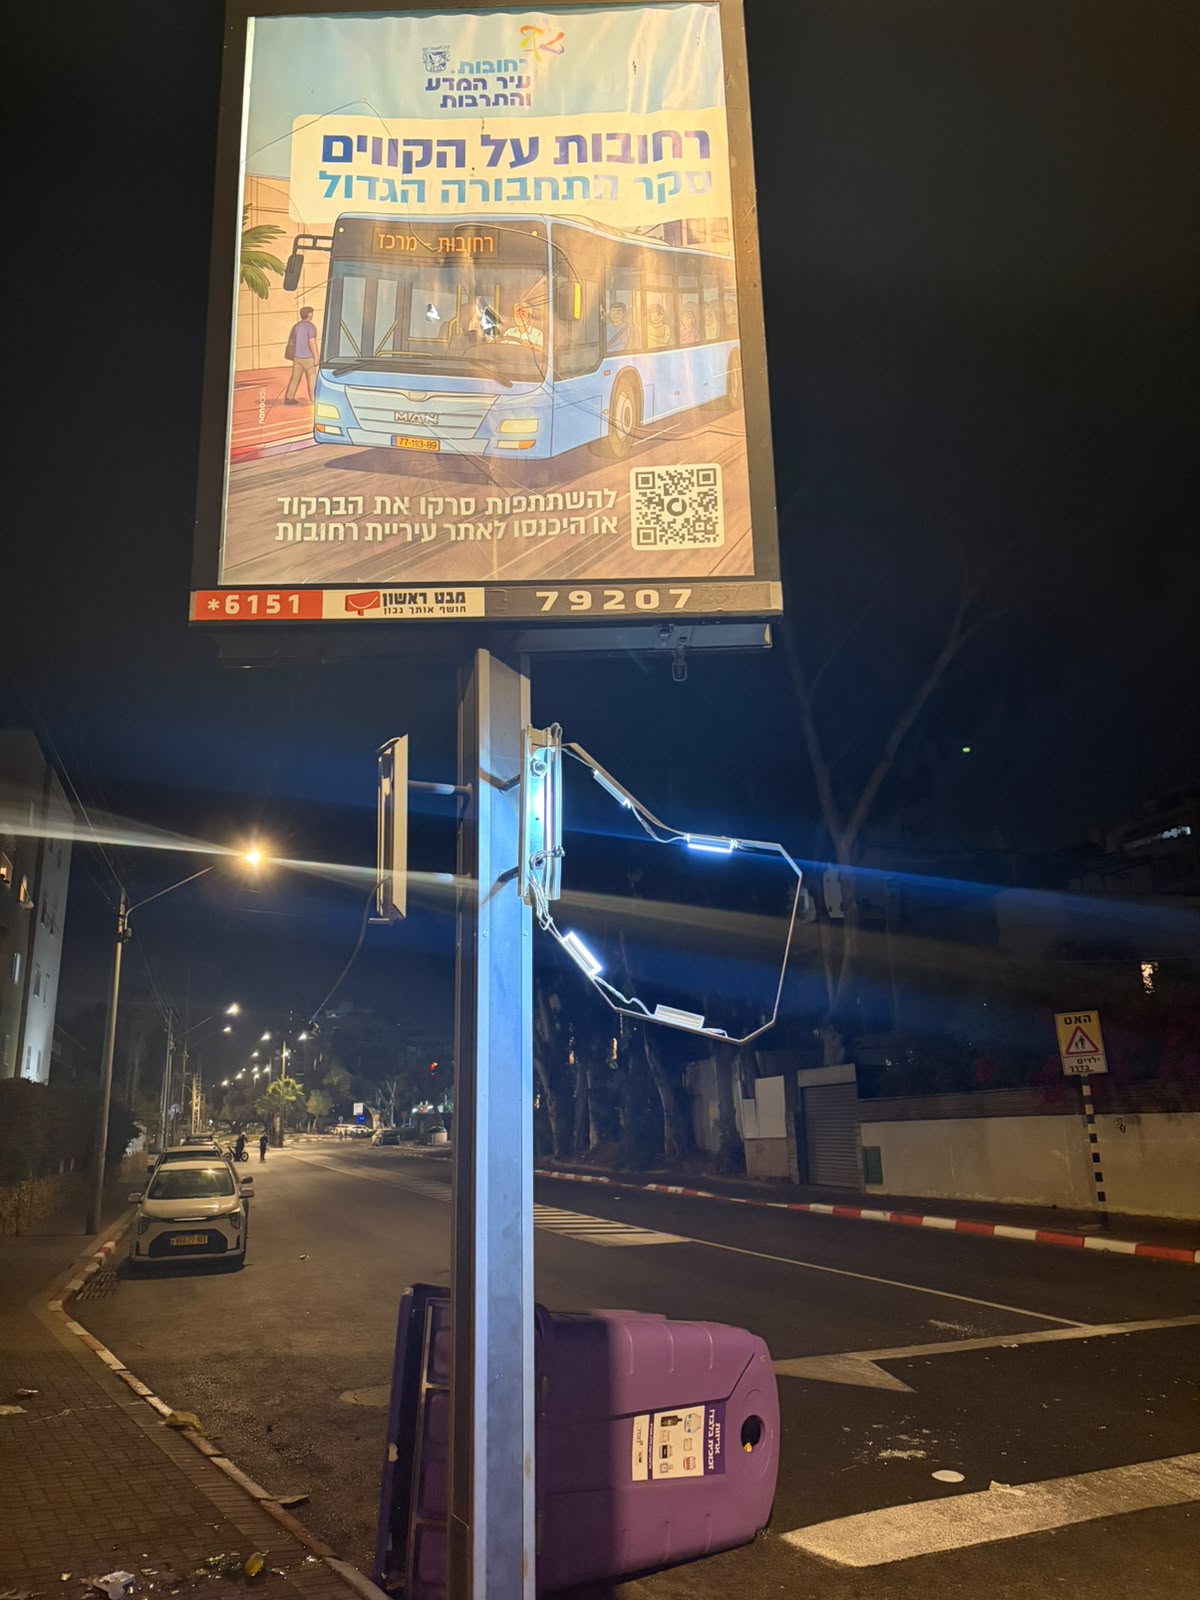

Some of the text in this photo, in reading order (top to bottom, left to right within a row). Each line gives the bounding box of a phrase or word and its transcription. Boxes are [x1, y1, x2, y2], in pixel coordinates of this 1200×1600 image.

[425, 76, 531, 91] עיר המדע
[440, 92, 531, 108] והתרבות
[321, 129, 710, 174] רחובות על הקווים
[318, 170, 712, 205] סקר התחבורה הגדול
[378, 234, 418, 251] מרכז
[437, 236, 494, 253] רחובות
[394, 411, 439, 425] MAN
[277, 487, 618, 520] להשתתפות סרקו את הברקוד
[275, 516, 618, 543] או היכנסו לאתר עיריית רחובות
[382, 592, 466, 607] מבט ראשון
[535, 588, 692, 612] 79207
[383, 606, 466, 615] חושף אותך נכון
[1063, 1015, 1092, 1025] האט
[1077, 1056, 1100, 1065] ילדים
[1069, 1065, 1092, 1073] בדרך
